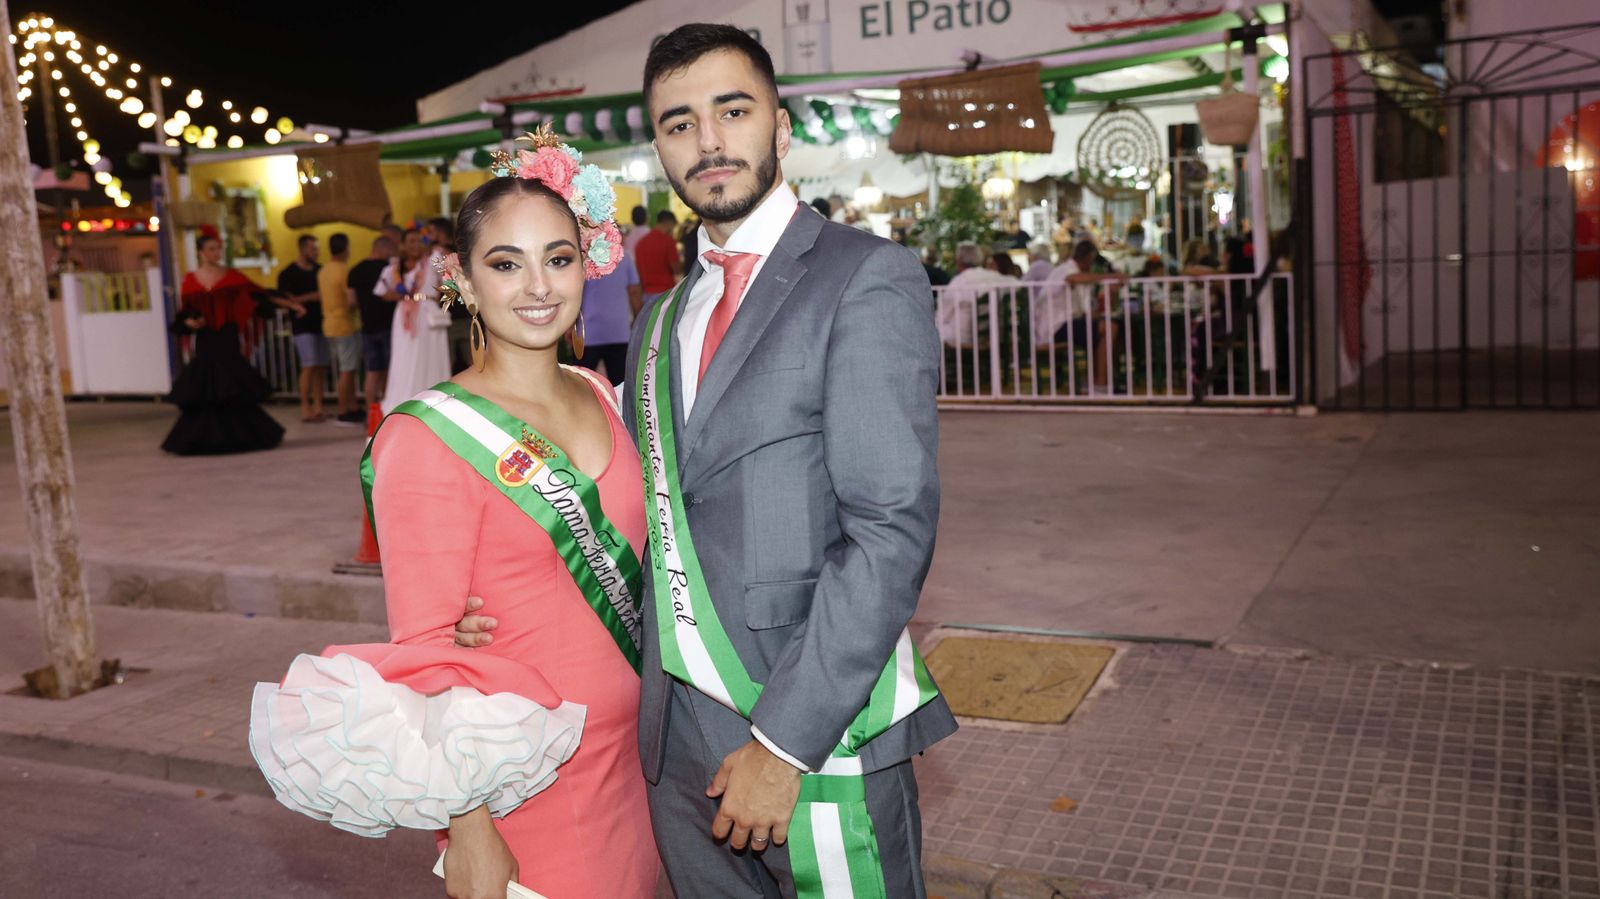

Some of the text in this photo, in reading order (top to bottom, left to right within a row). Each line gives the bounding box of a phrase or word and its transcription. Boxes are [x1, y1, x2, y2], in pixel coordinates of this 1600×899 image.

[860, 0, 1011, 39] El Patio
[532, 468, 591, 545] Dama
[580, 529, 621, 595] Feria
[649, 515, 662, 570] 2023
[656, 492, 674, 555] Feria
[667, 568, 697, 627] Real
